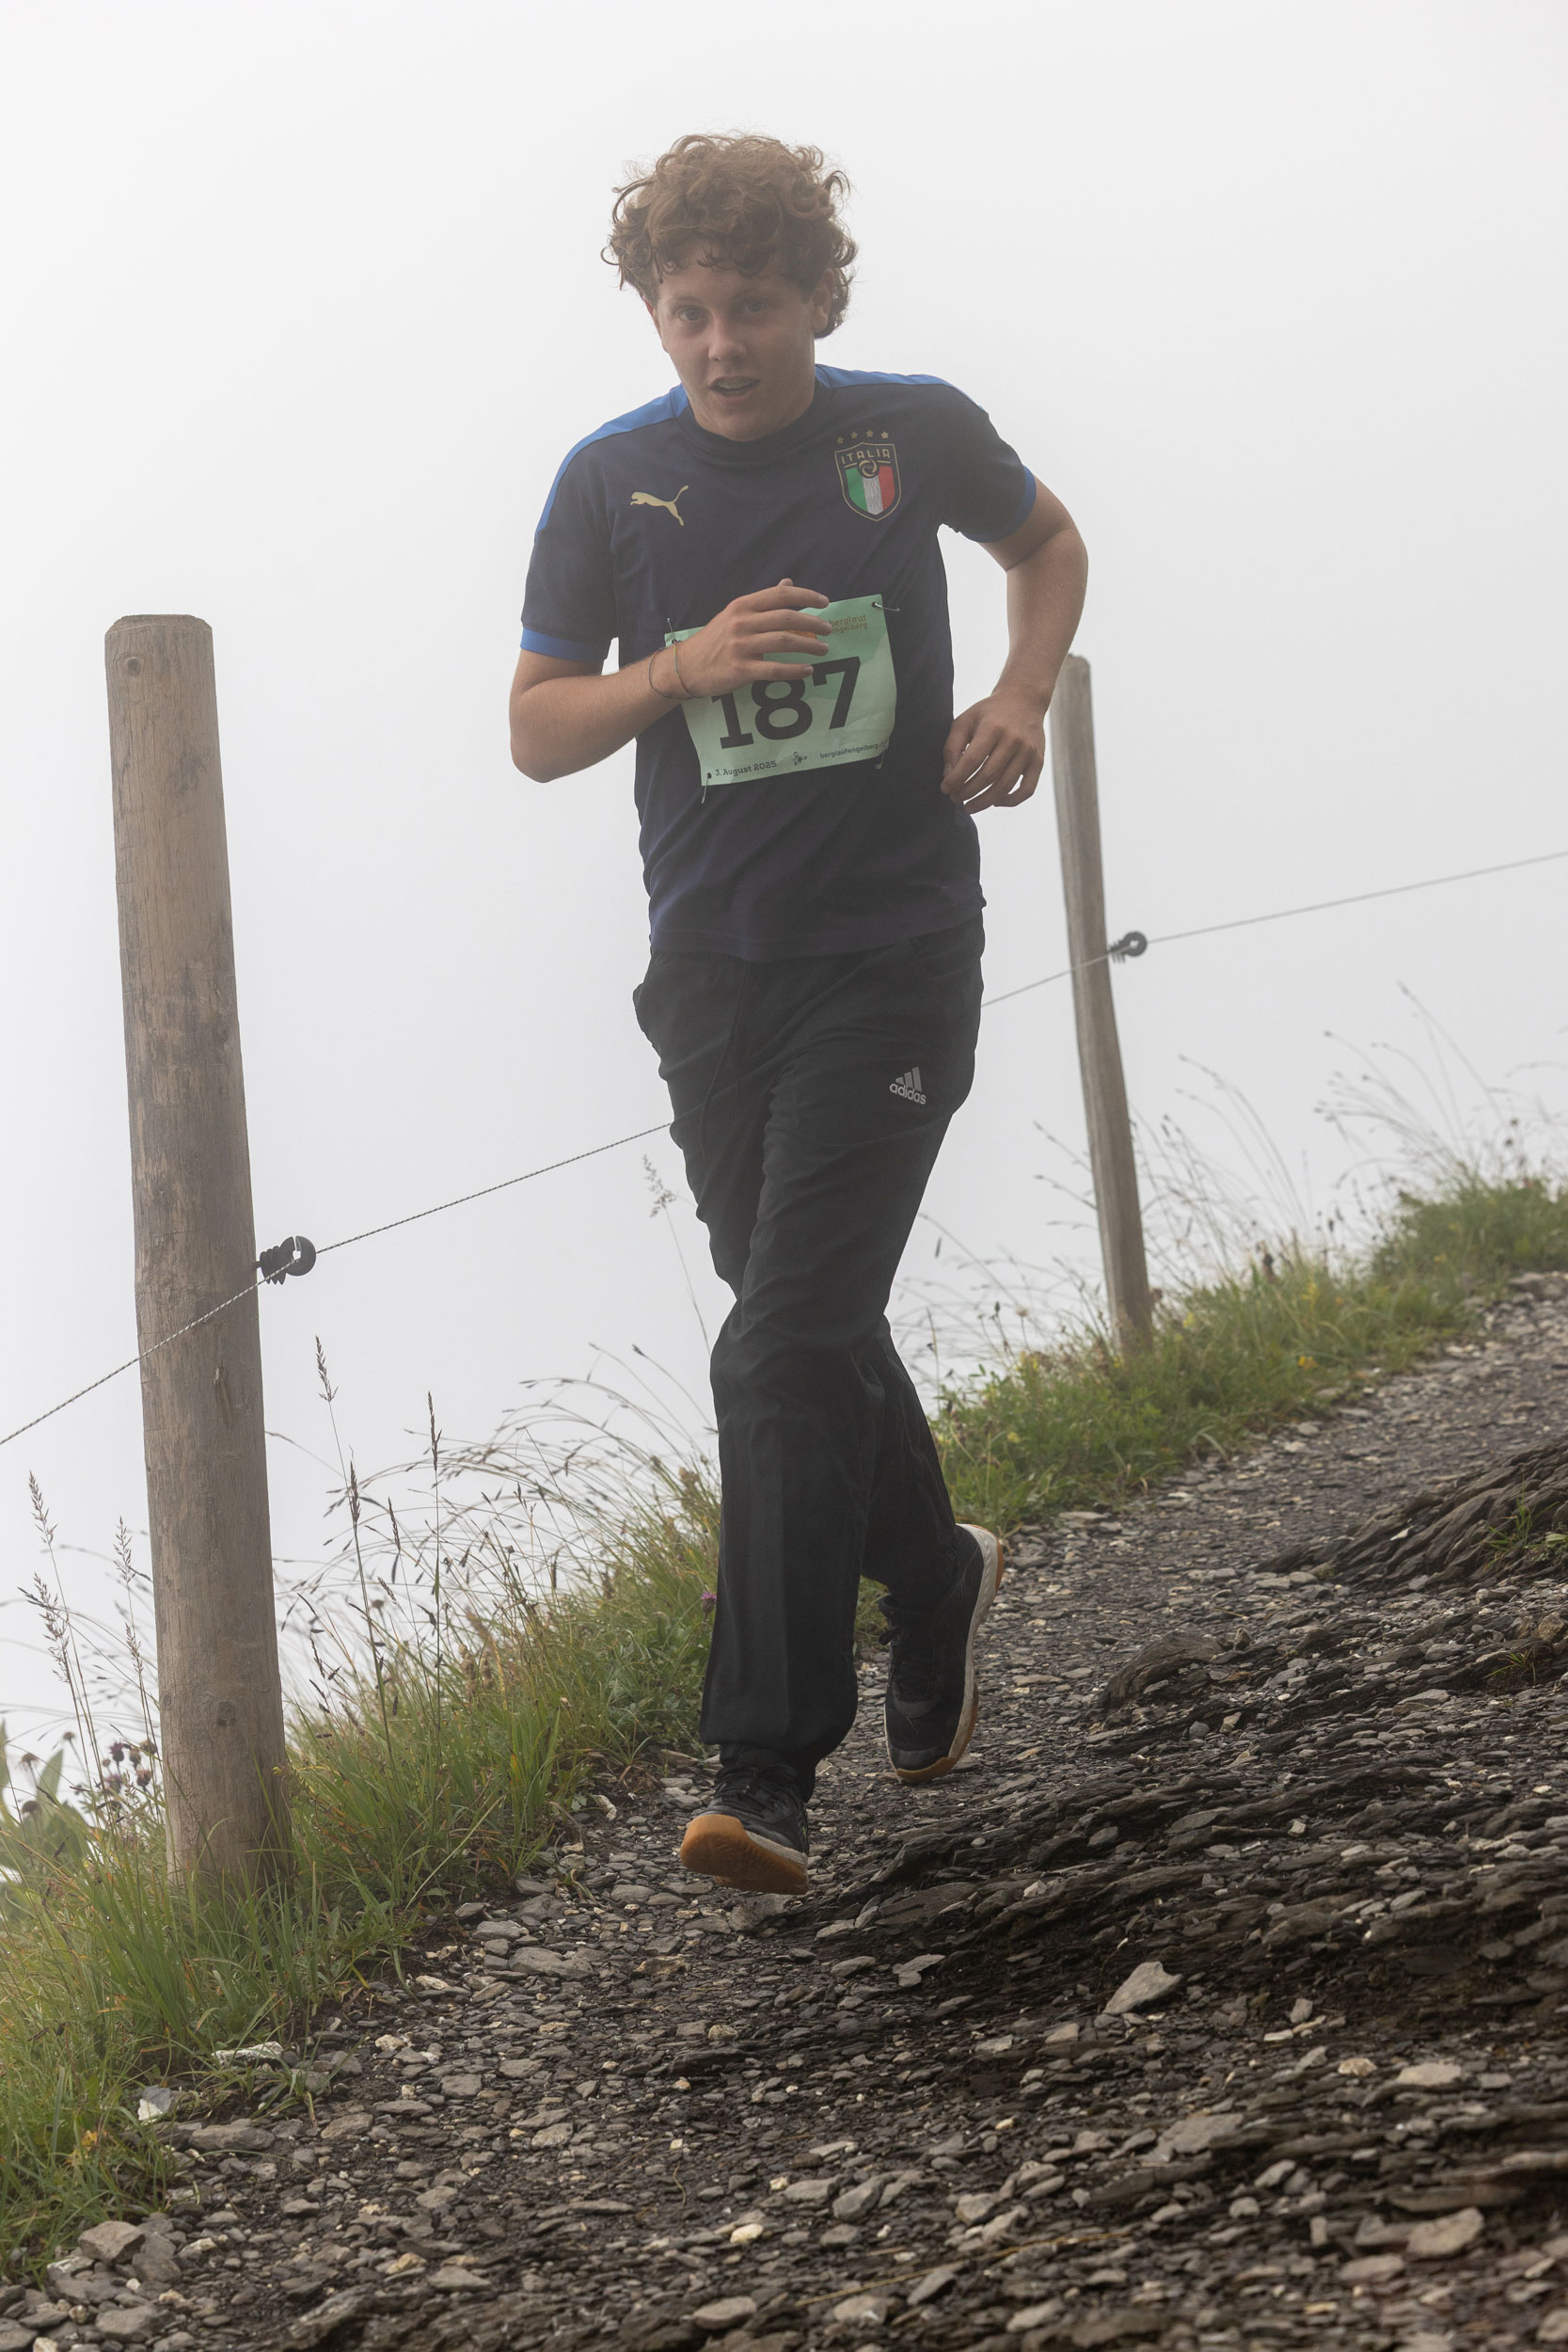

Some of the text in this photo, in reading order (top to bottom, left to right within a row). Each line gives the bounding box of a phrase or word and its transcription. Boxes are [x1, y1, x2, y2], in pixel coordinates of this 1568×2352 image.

[841, 448, 890, 464] ITALIA
[829, 614, 866, 627] berglauf
[711, 656, 862, 750] 187
[722, 766, 752, 777] August
[753, 760, 777, 771] 2025
[889, 1083, 927, 1105] adidas
